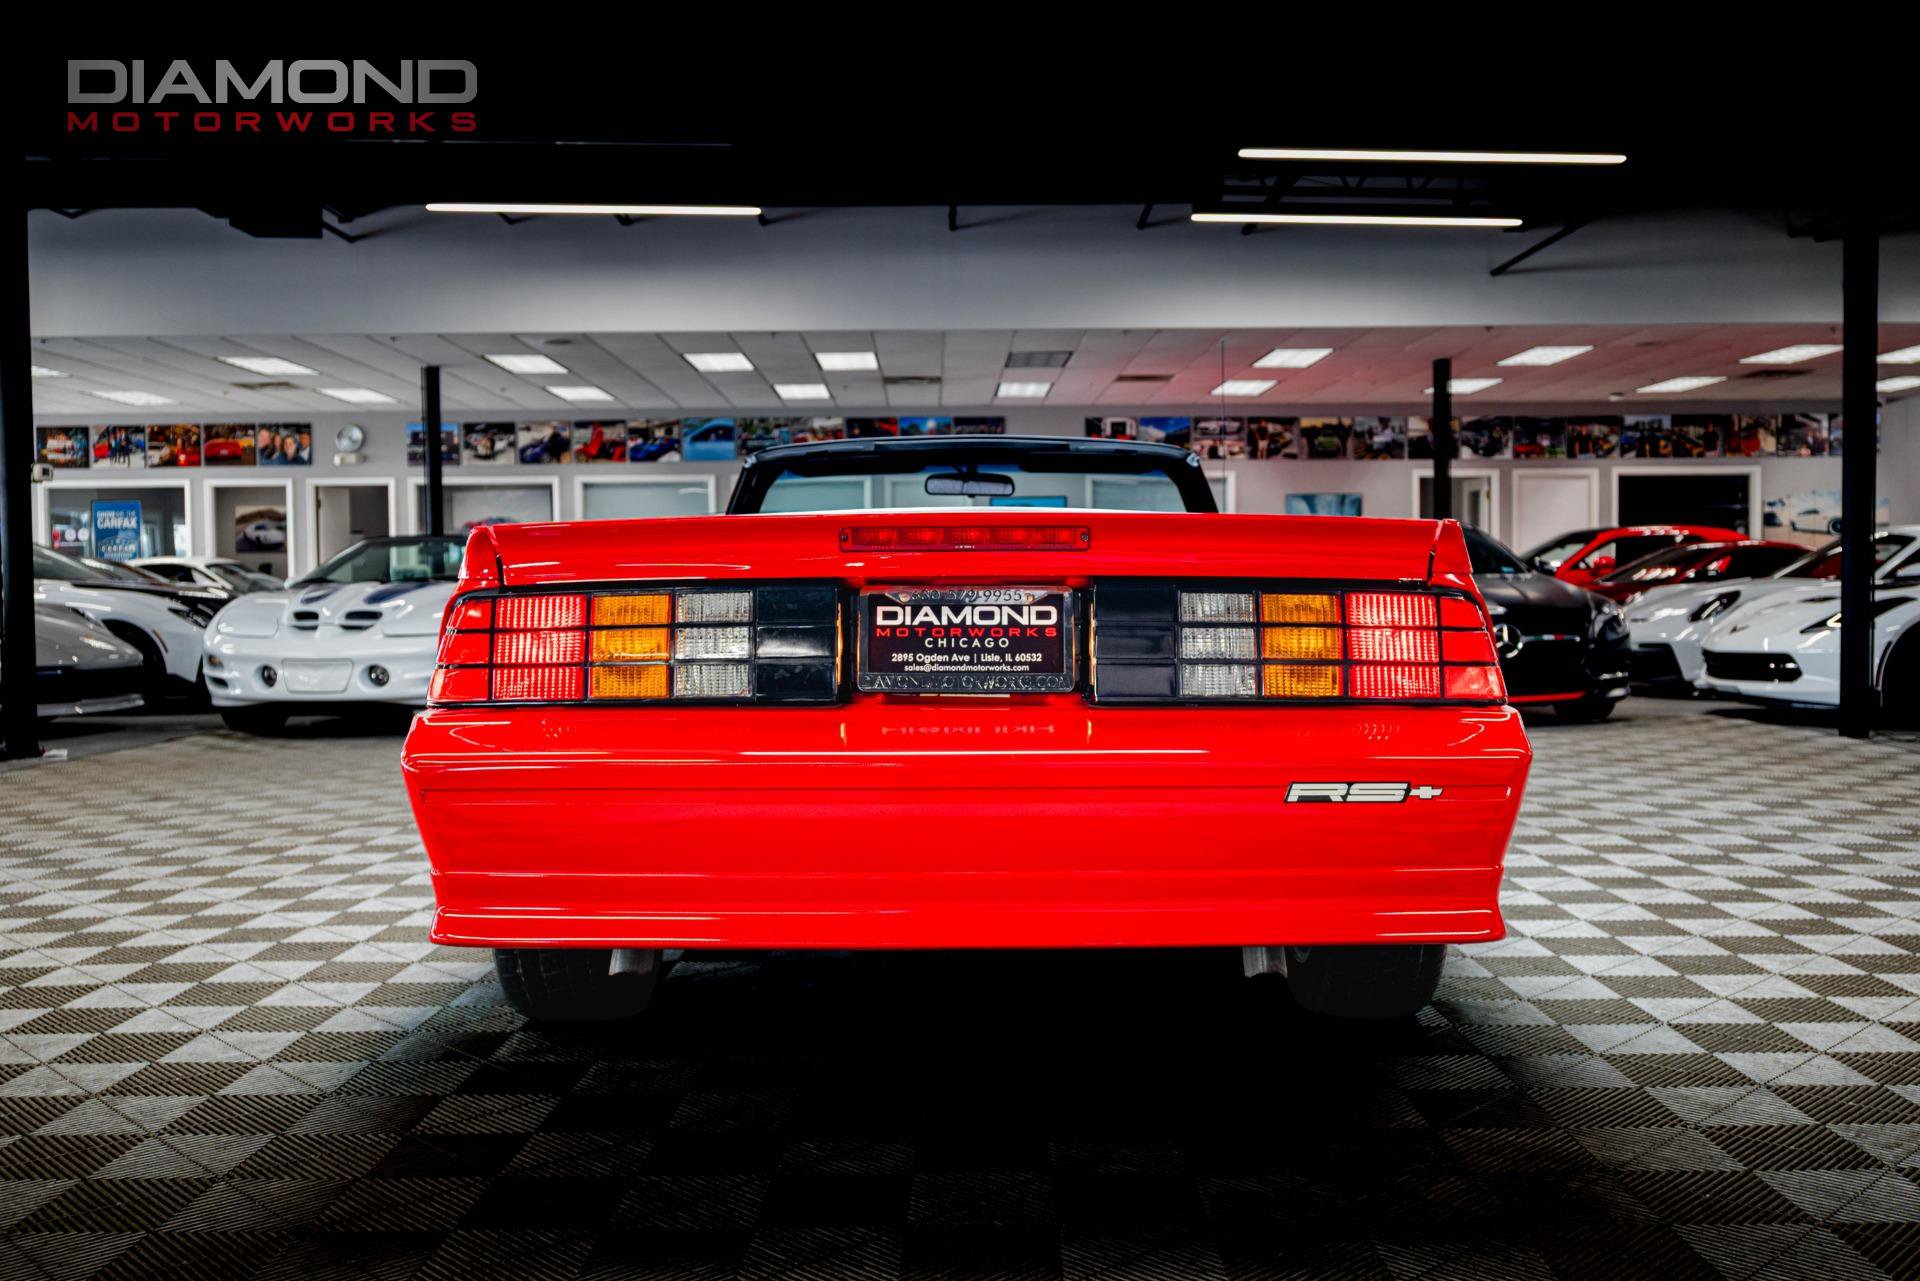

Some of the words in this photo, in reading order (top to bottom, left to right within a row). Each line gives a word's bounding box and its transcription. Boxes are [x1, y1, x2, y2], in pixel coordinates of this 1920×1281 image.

[97, 517, 137, 530] CARFAX
[876, 605, 1058, 626] DIAMOND
[876, 627, 1057, 638] MOTORWORKS
[924, 637, 1010, 649] CHICAGO
[891, 652, 914, 662] 2895
[916, 652, 949, 664] Ogden
[951, 652, 970, 662] Ave
[980, 652, 1003, 663] Lisle,
[1005, 653, 1013, 662] IL
[1014, 652, 1042, 662] 60532
[904, 663, 1030, 673] sales@diamondmotorworks.com
